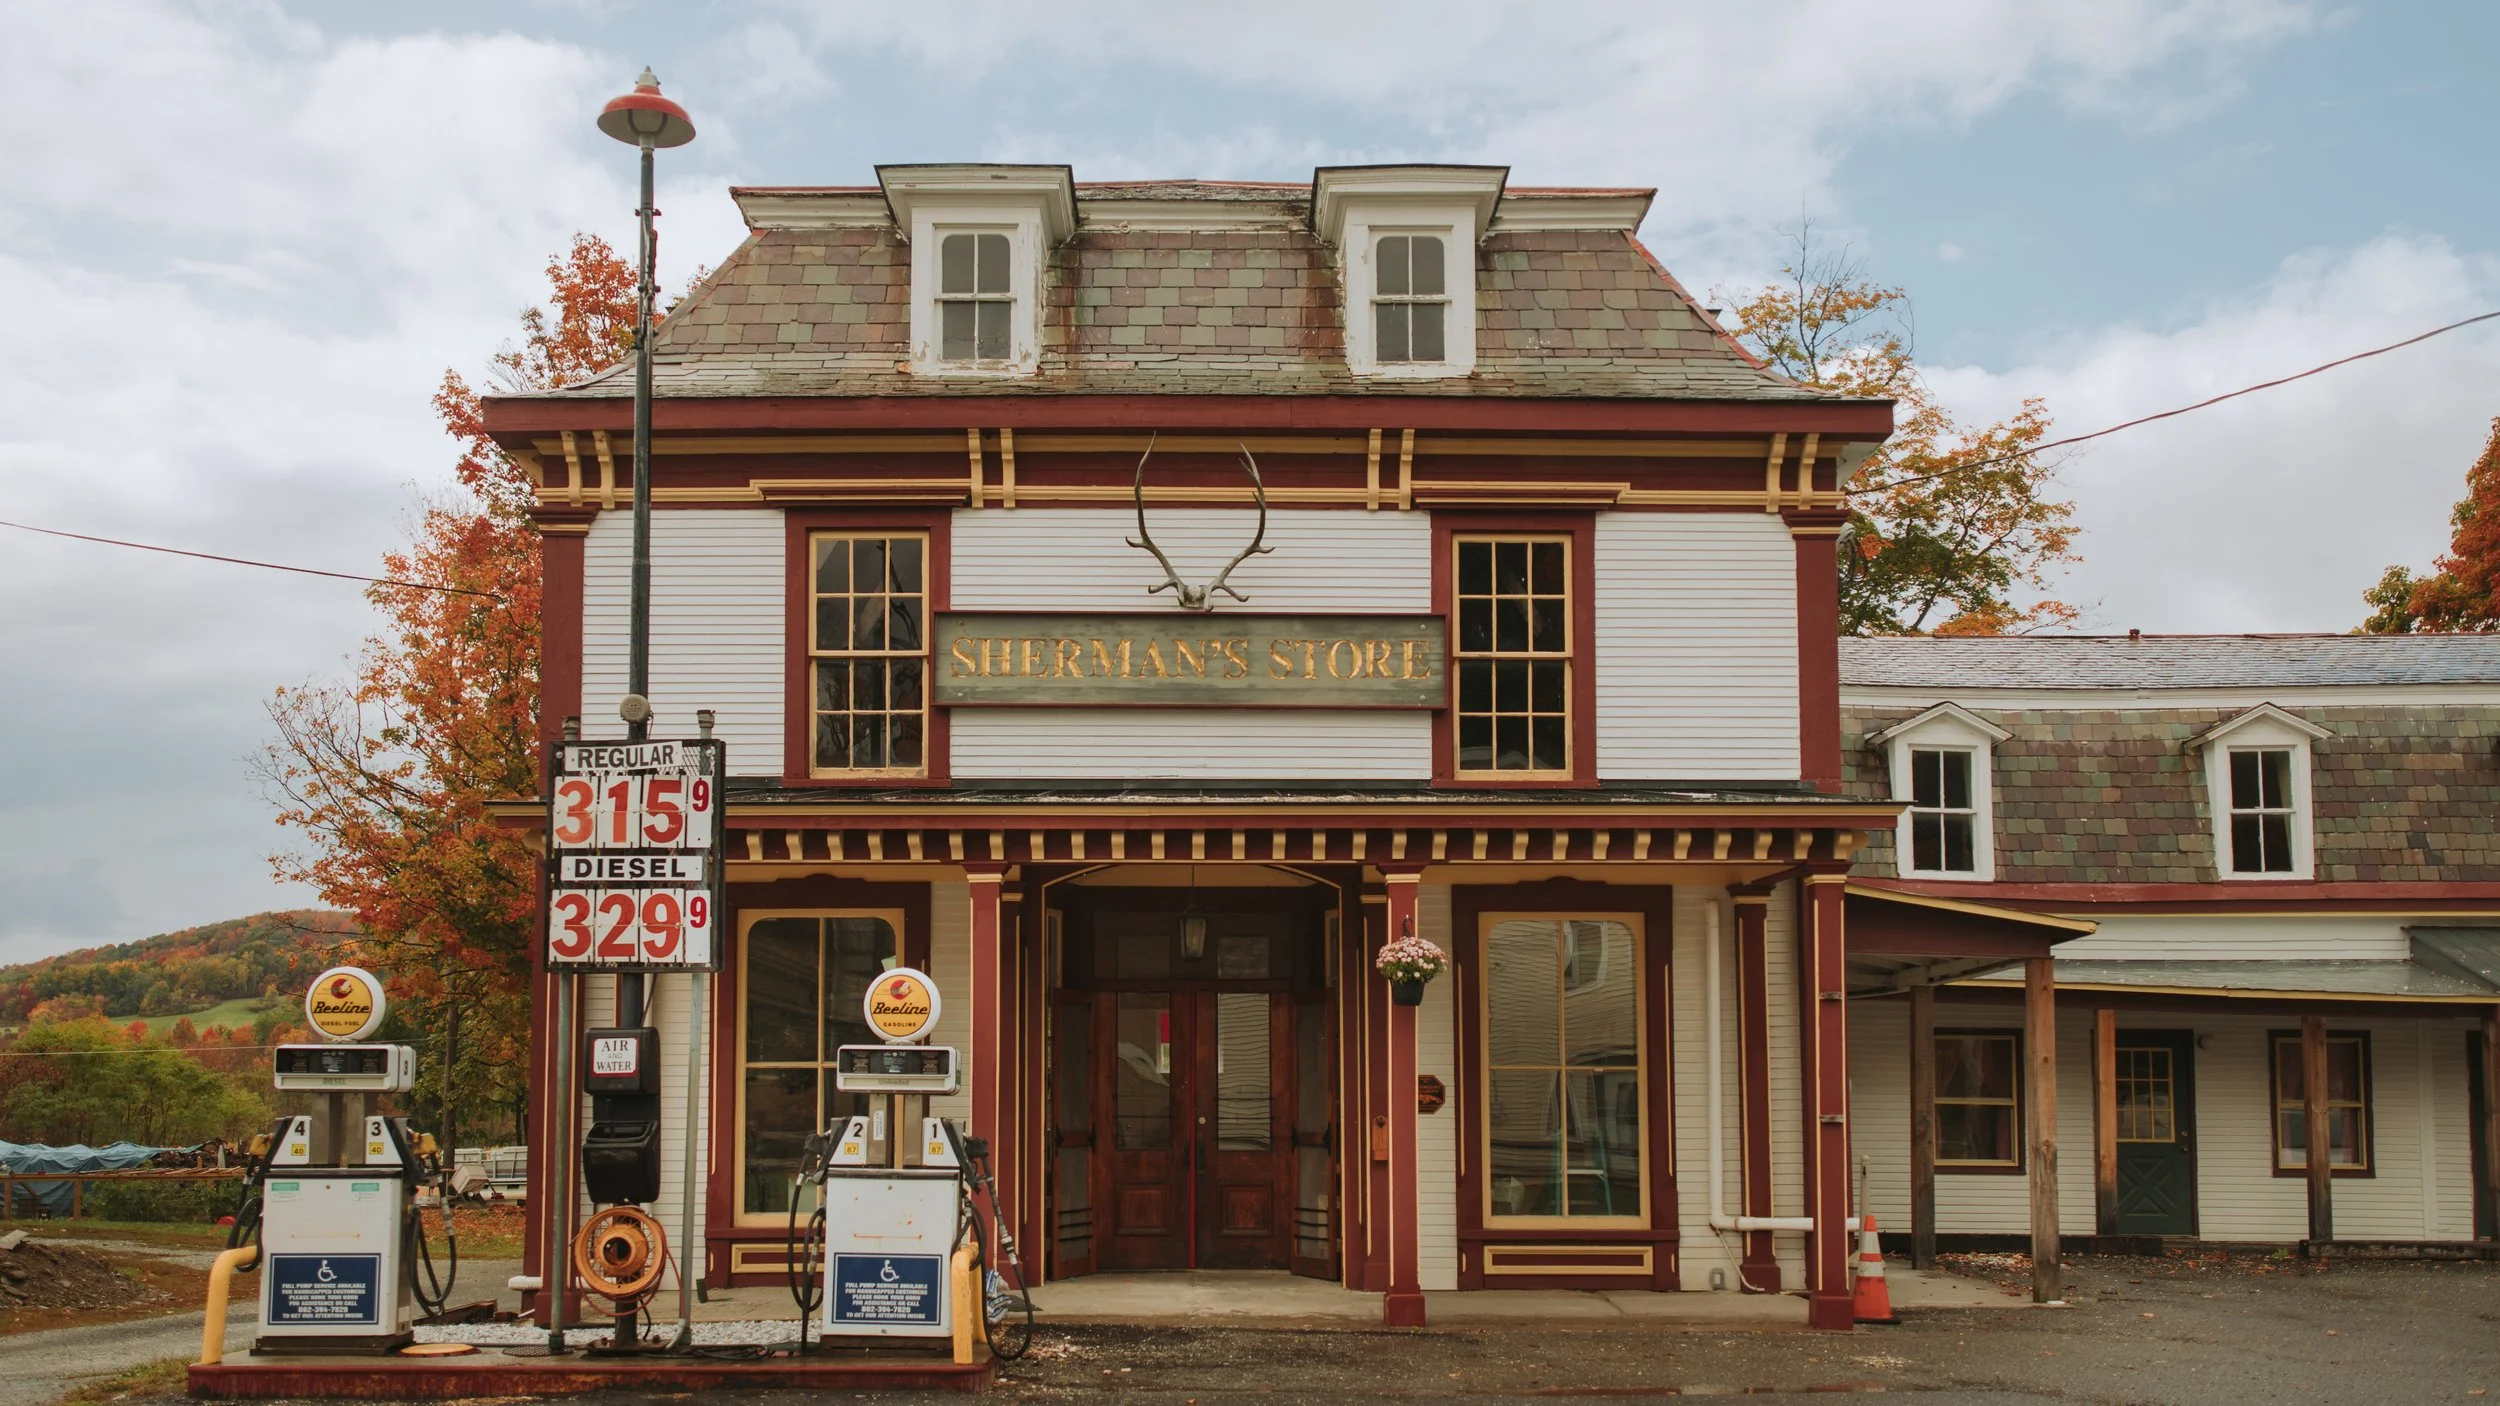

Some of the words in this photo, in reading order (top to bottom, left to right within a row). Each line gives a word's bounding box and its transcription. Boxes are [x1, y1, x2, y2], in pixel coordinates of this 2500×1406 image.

[950, 635, 1249, 679] SHERMAN'S
[1268, 638, 1431, 679] STORE
[577, 744, 674, 769] REGULAR
[574, 858, 686, 878] DIESEL
[313, 1001, 370, 1014] Beeline
[872, 1002, 929, 1015] Beeline
[601, 1040, 629, 1052] AIR
[596, 1061, 632, 1072] WATER
[294, 1120, 306, 1136] 4
[371, 1121, 382, 1137] 3
[853, 1122, 864, 1138] 2
[931, 1123, 939, 1139] 1
[846, 1145, 857, 1153] 87
[931, 1145, 942, 1153] 87
